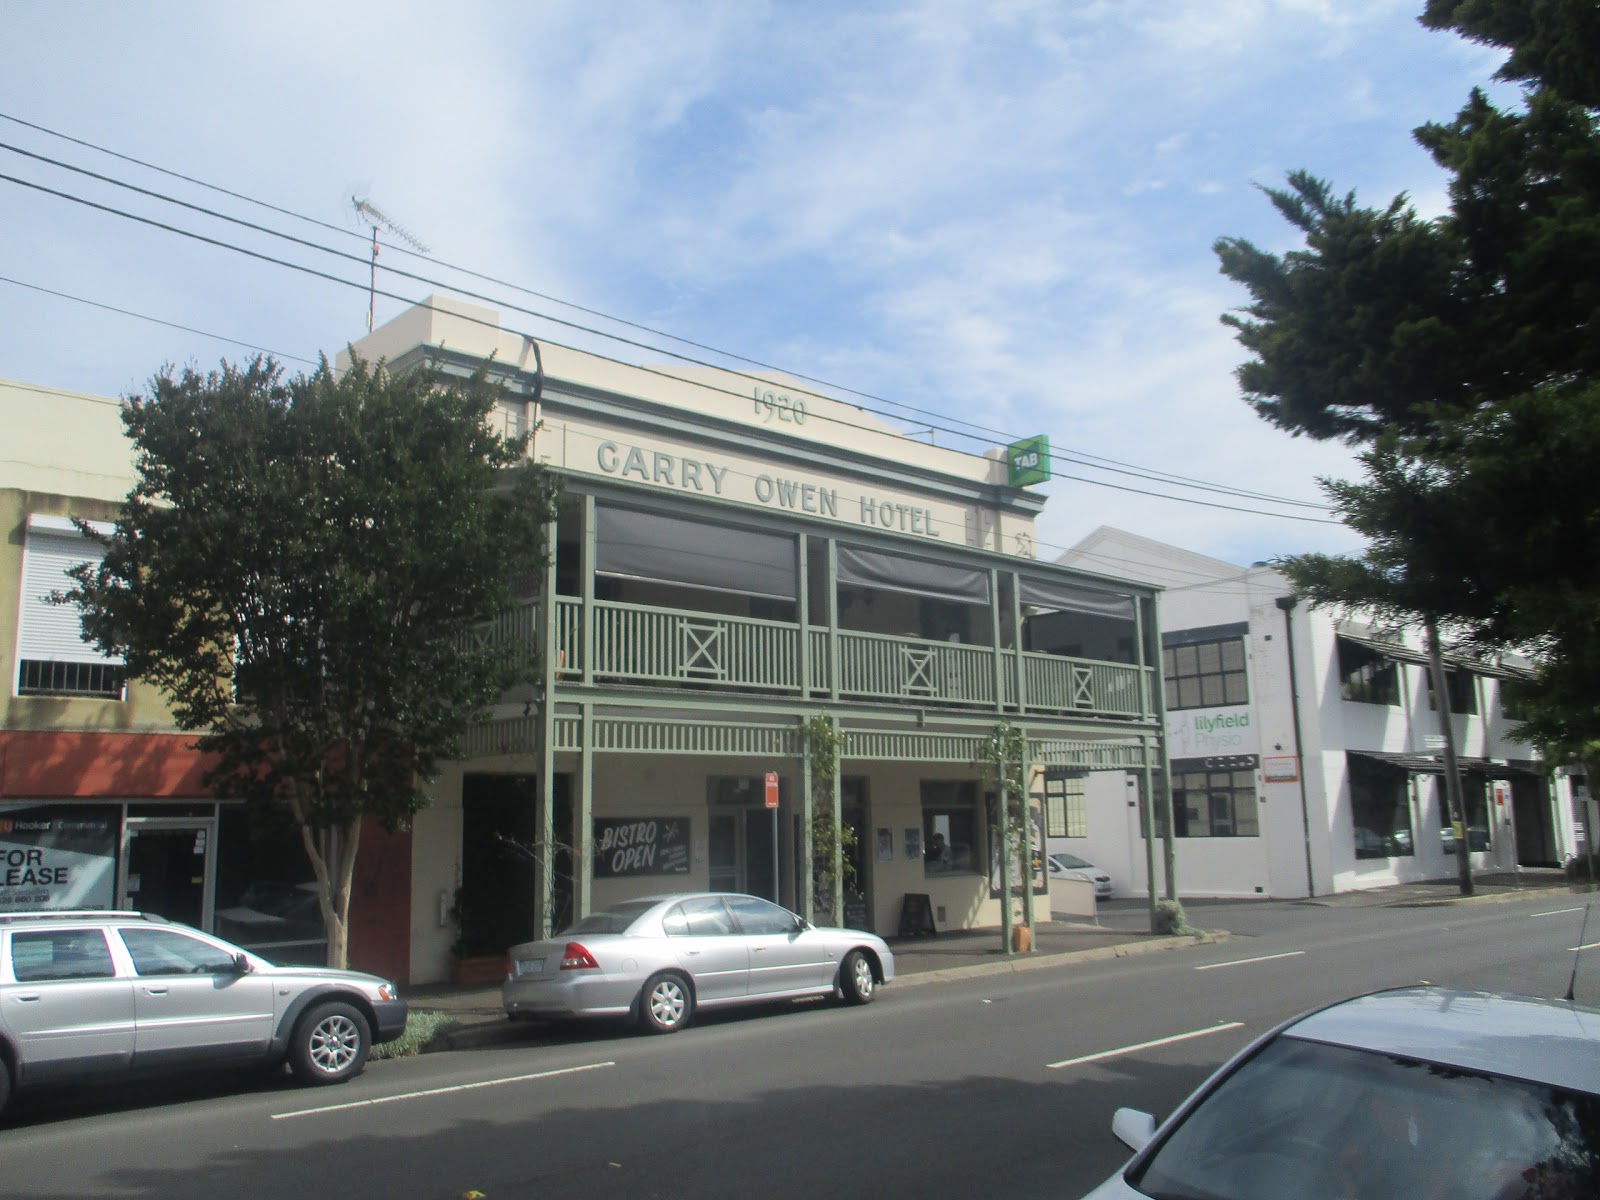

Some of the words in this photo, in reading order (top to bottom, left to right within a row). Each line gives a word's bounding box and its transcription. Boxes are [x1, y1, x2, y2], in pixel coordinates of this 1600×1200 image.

[754, 387, 806, 425] 1920
[1014, 452, 1038, 470] TAB
[597, 440, 728, 494] GARRY
[755, 473, 838, 516] OWEN
[860, 495, 940, 537] HOTEL
[1194, 712, 1249, 733] lilyfield
[15, 821, 51, 830] Hooker
[601, 821, 657, 850] BISTRO
[612, 843, 656, 873] OPEN
[0, 866, 69, 886] EASE
